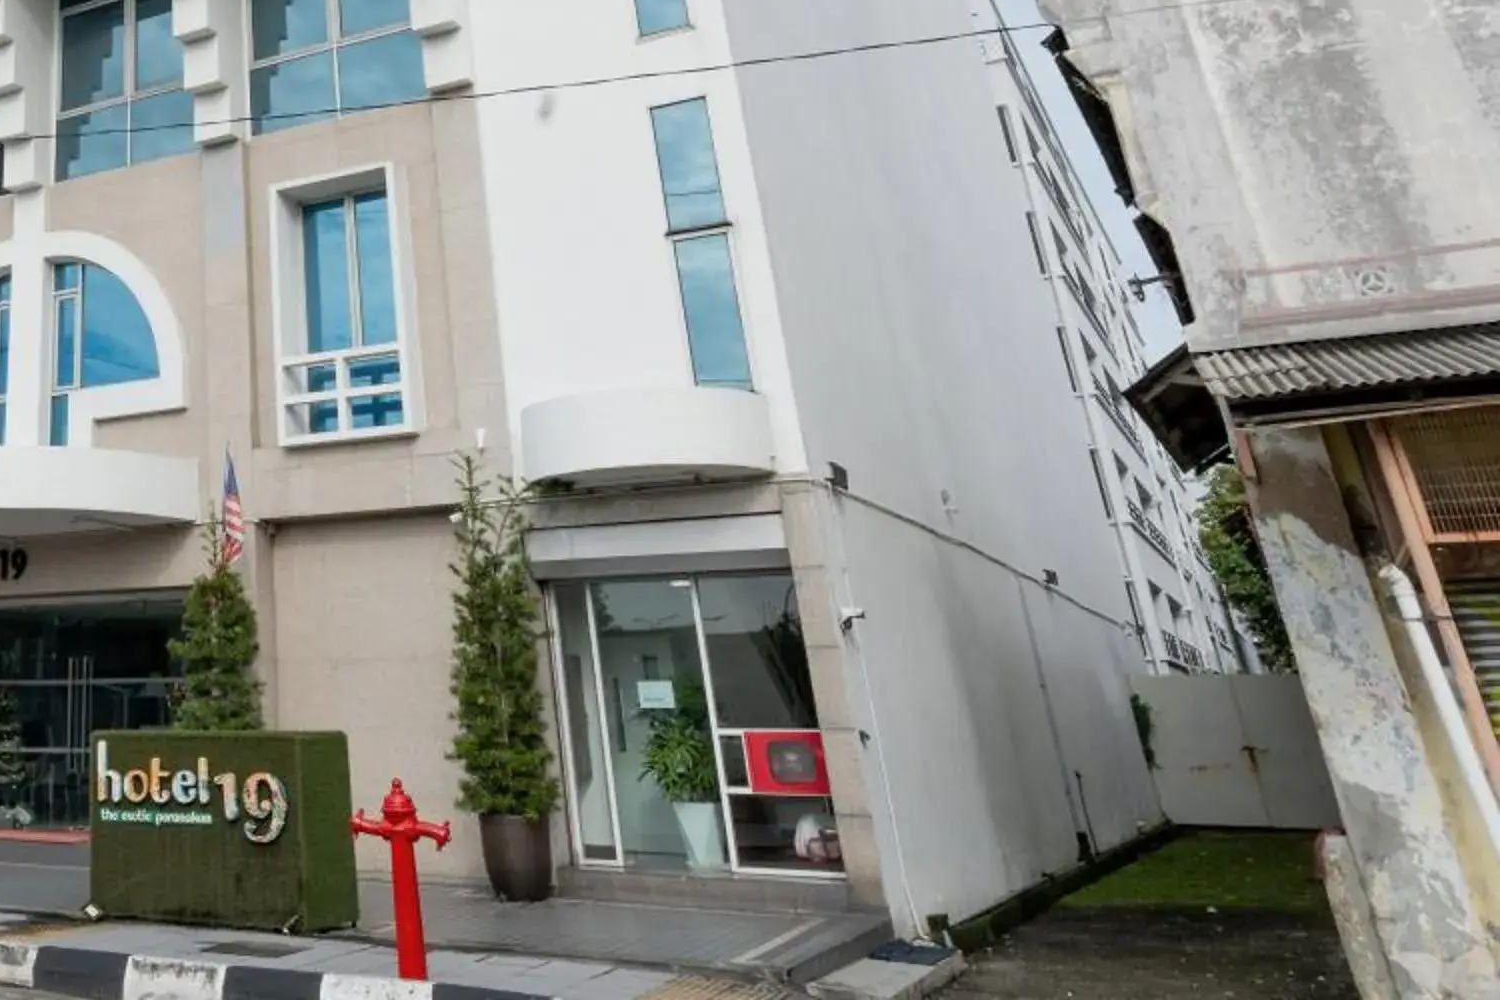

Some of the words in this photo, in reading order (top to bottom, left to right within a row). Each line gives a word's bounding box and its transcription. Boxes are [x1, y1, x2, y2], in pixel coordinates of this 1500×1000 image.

[97, 739, 211, 804] hotel
[213, 771, 288, 843] 19
[100, 807, 119, 821] the
